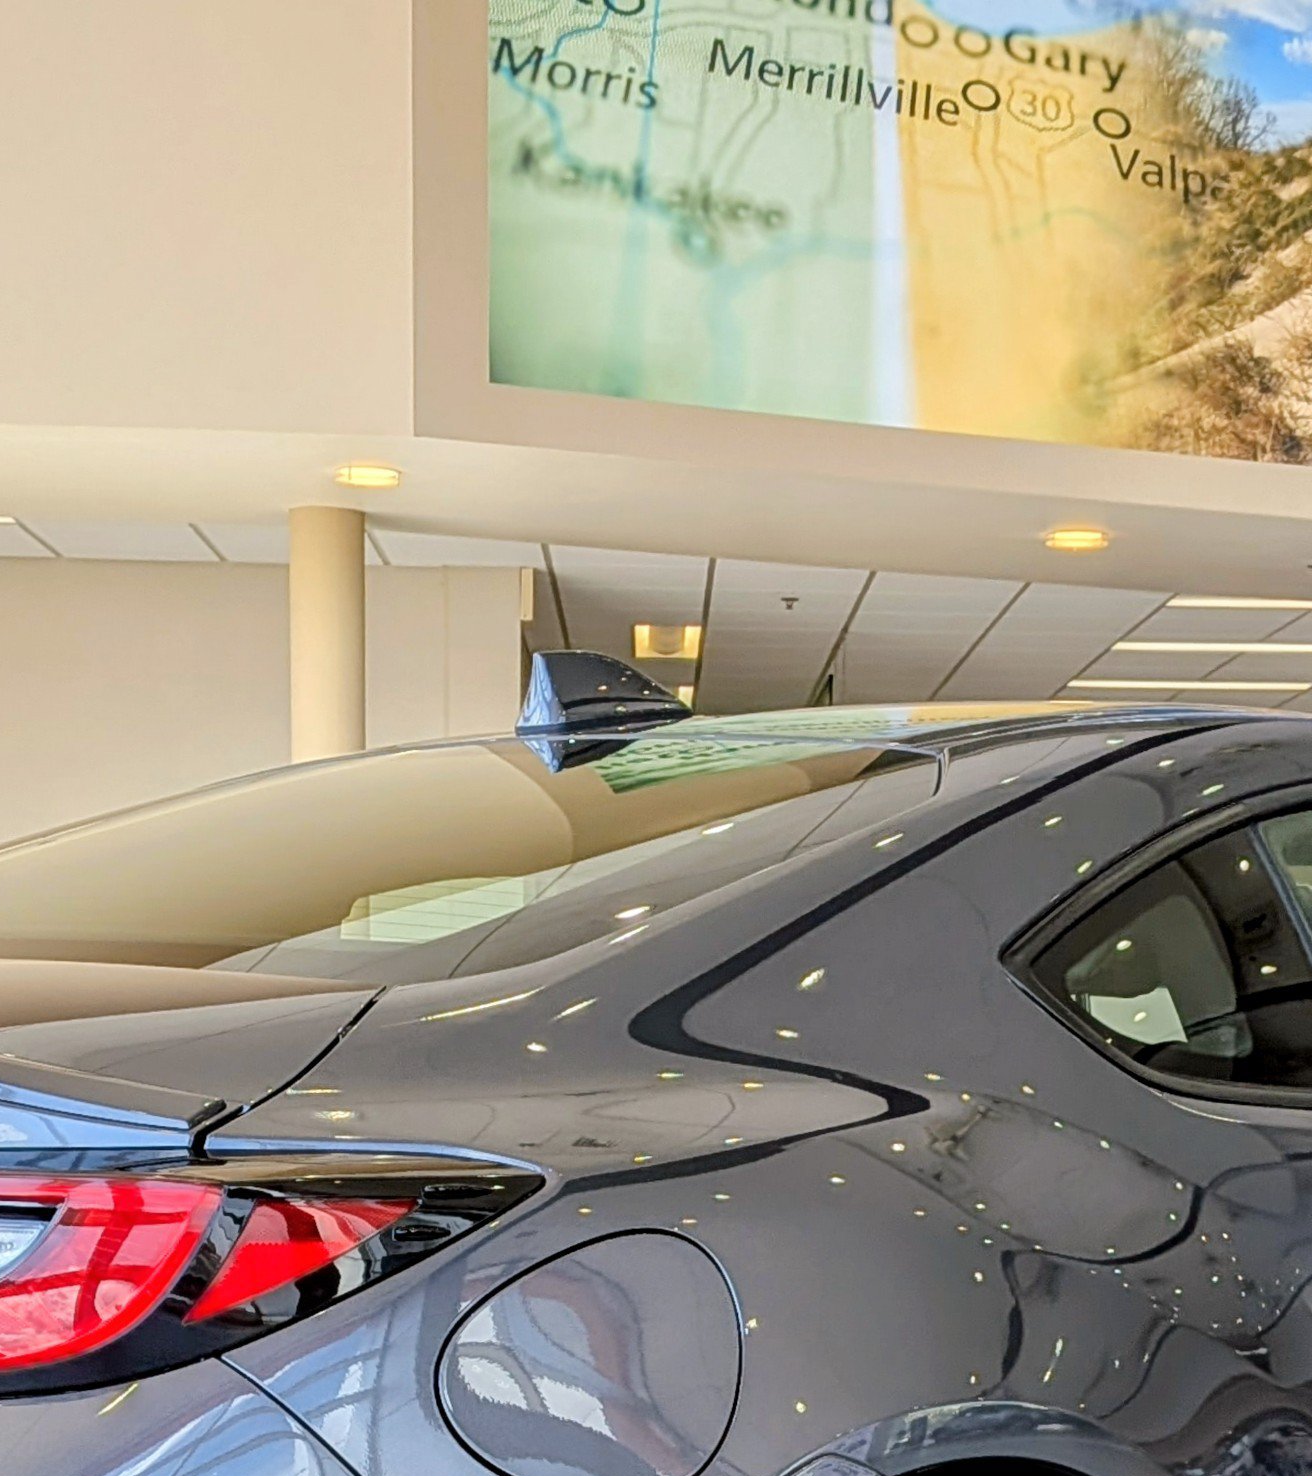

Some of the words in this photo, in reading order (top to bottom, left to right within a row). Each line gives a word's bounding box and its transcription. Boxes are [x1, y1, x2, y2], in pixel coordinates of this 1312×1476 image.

[491, 37, 660, 110] Morris
[708, 38, 962, 127] Merrillville
[1001, 31, 1128, 92] Gary
[1020, 92, 1061, 122] 30
